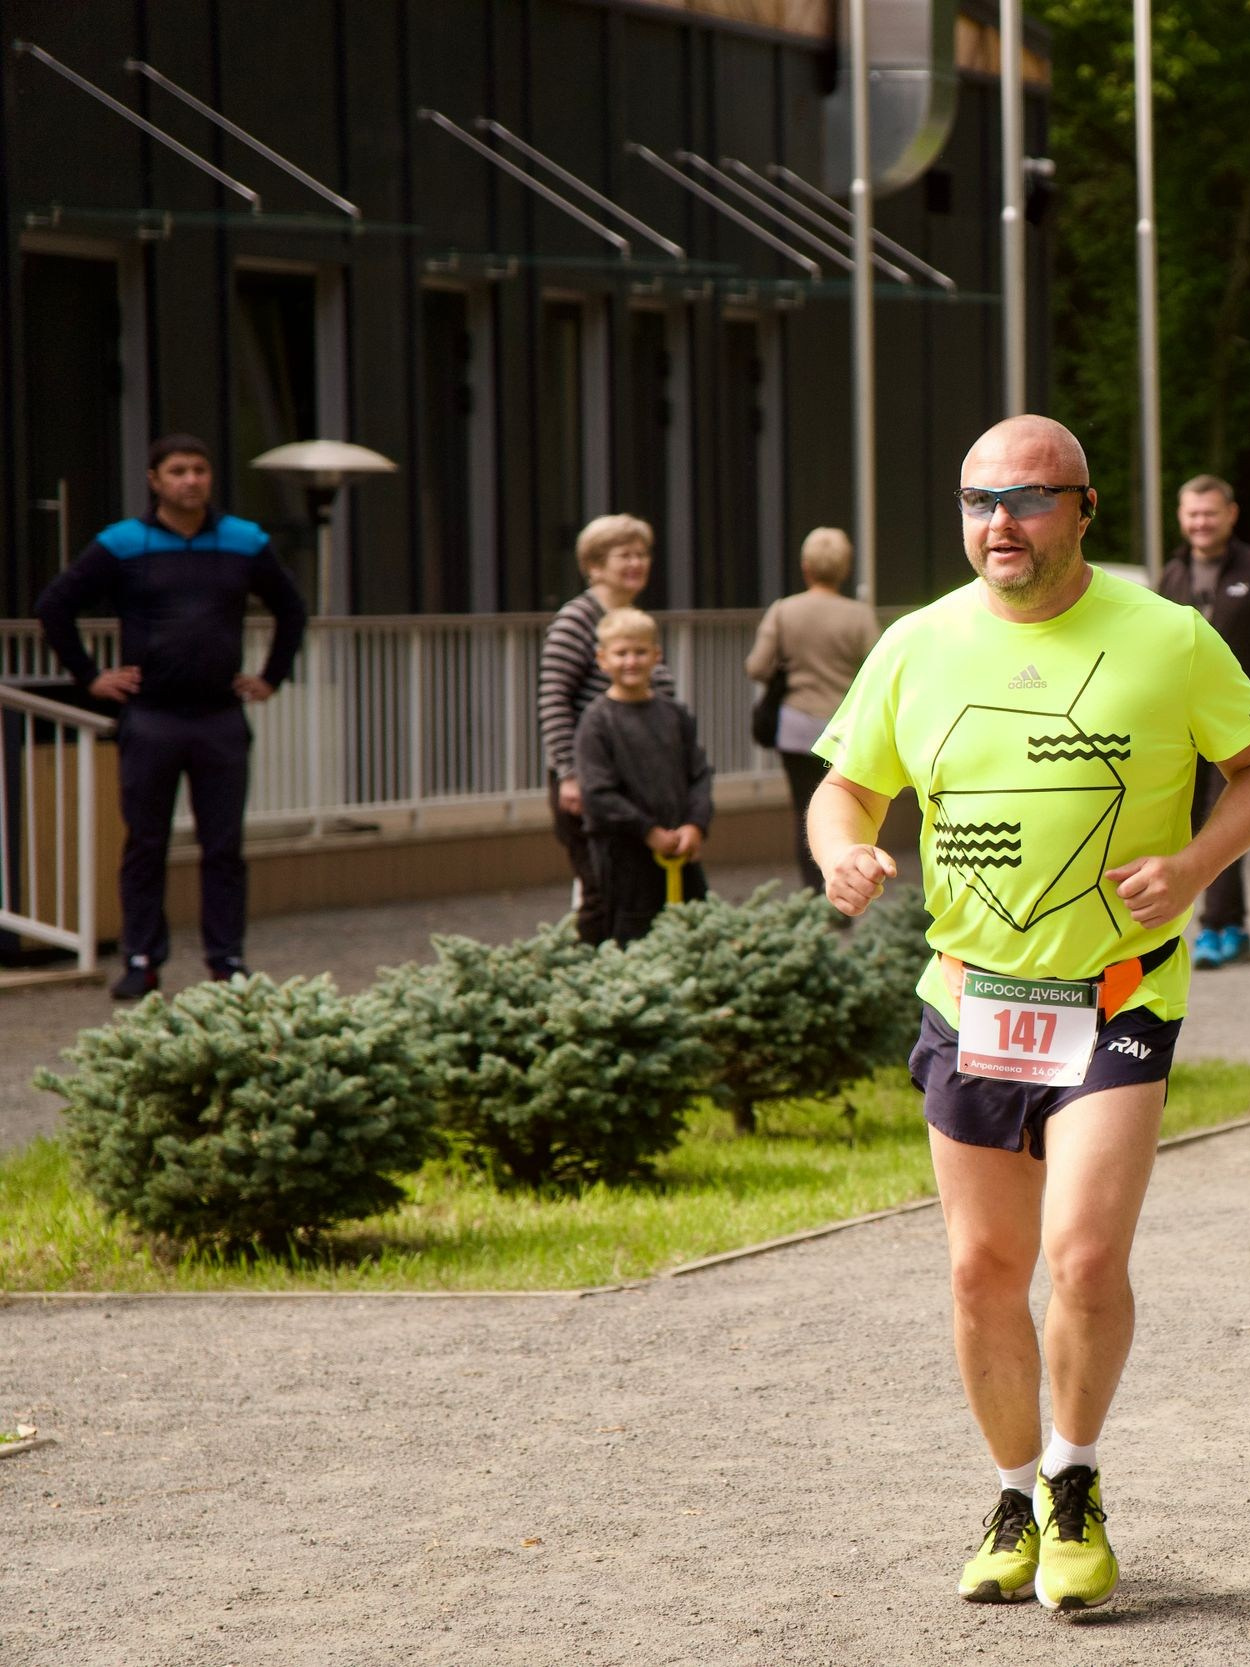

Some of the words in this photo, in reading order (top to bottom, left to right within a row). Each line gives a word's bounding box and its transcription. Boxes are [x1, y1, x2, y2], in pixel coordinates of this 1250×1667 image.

[1008, 679, 1048, 689] adidas
[974, 980, 1026, 998] КРОСС
[1029, 987, 1083, 1003] ДУБКИ
[994, 1008, 1057, 1055] 147
[1107, 1036, 1152, 1060] RAY
[970, 1059, 1023, 1073] Апрелевка
